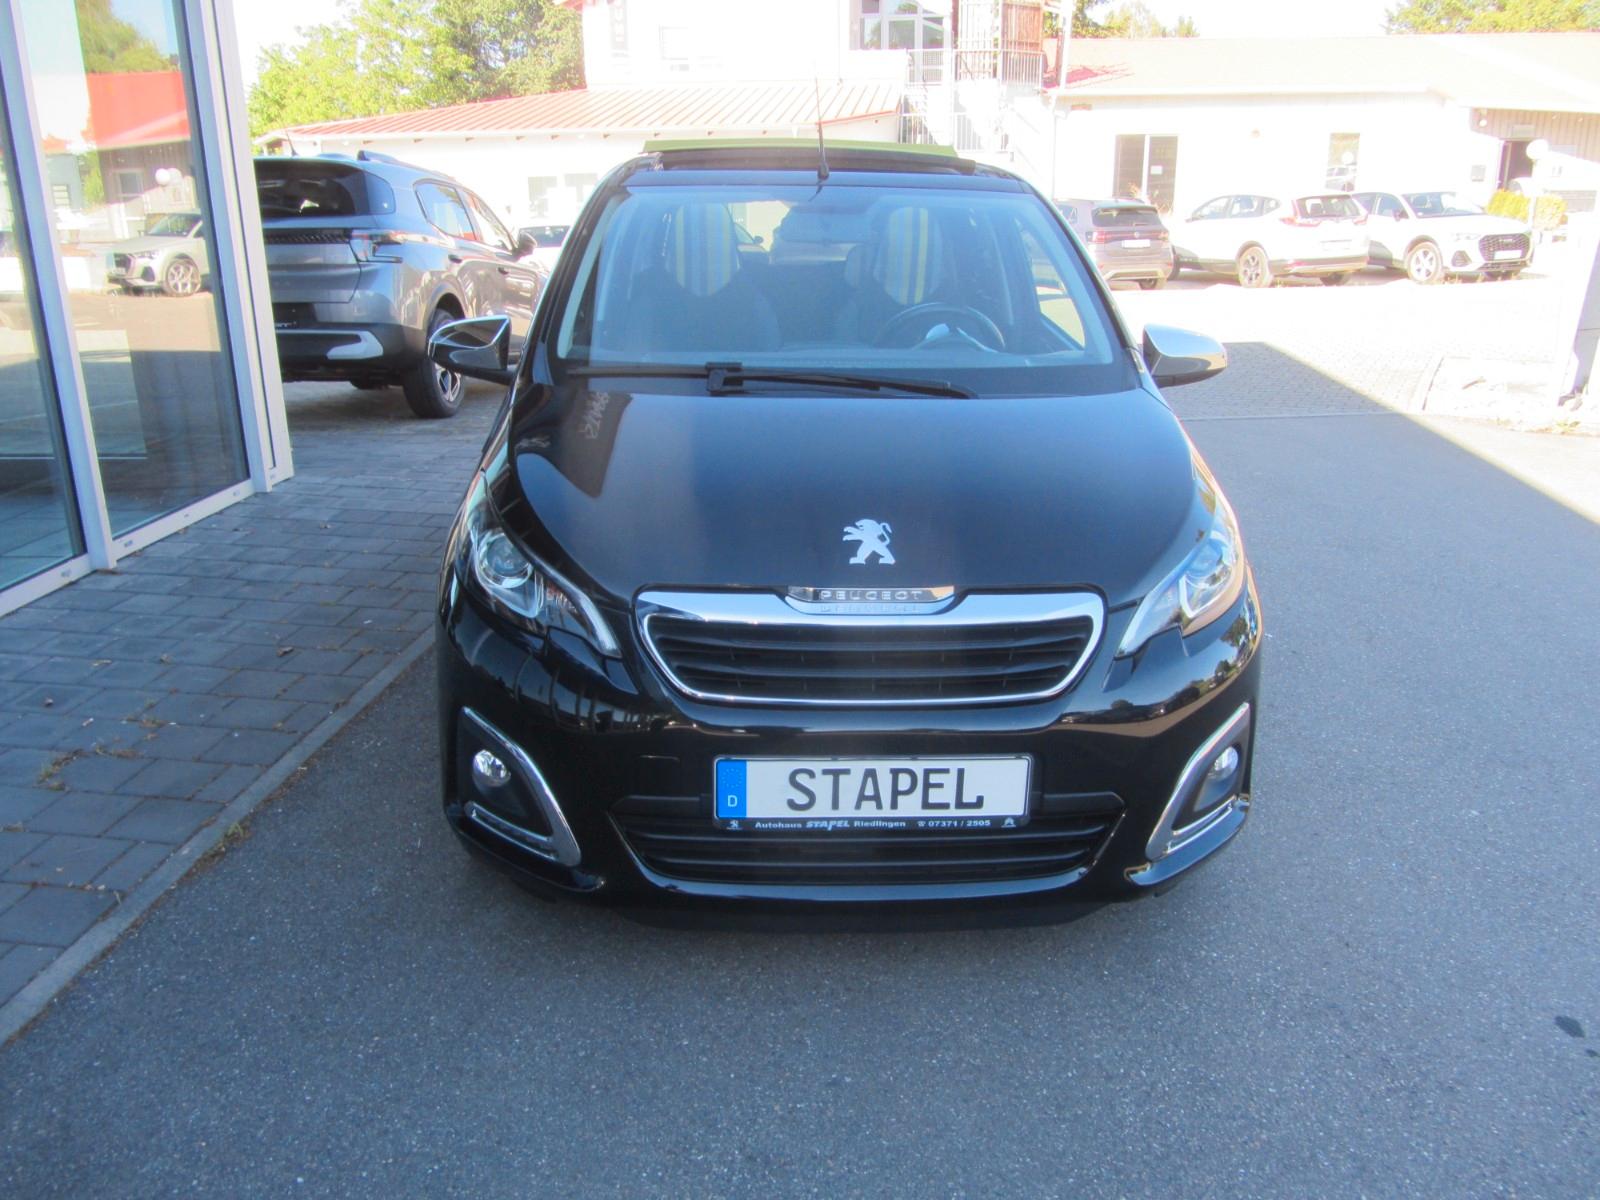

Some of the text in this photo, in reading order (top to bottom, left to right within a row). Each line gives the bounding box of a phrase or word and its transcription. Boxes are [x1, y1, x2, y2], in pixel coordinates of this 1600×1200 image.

[786, 767, 985, 811] STAPEL
[727, 795, 738, 807] D
[755, 821, 802, 829] Autohaus
[805, 820, 850, 831] STAPEL
[853, 820, 906, 828] Riedlingen
[966, 819, 991, 827] 2505
